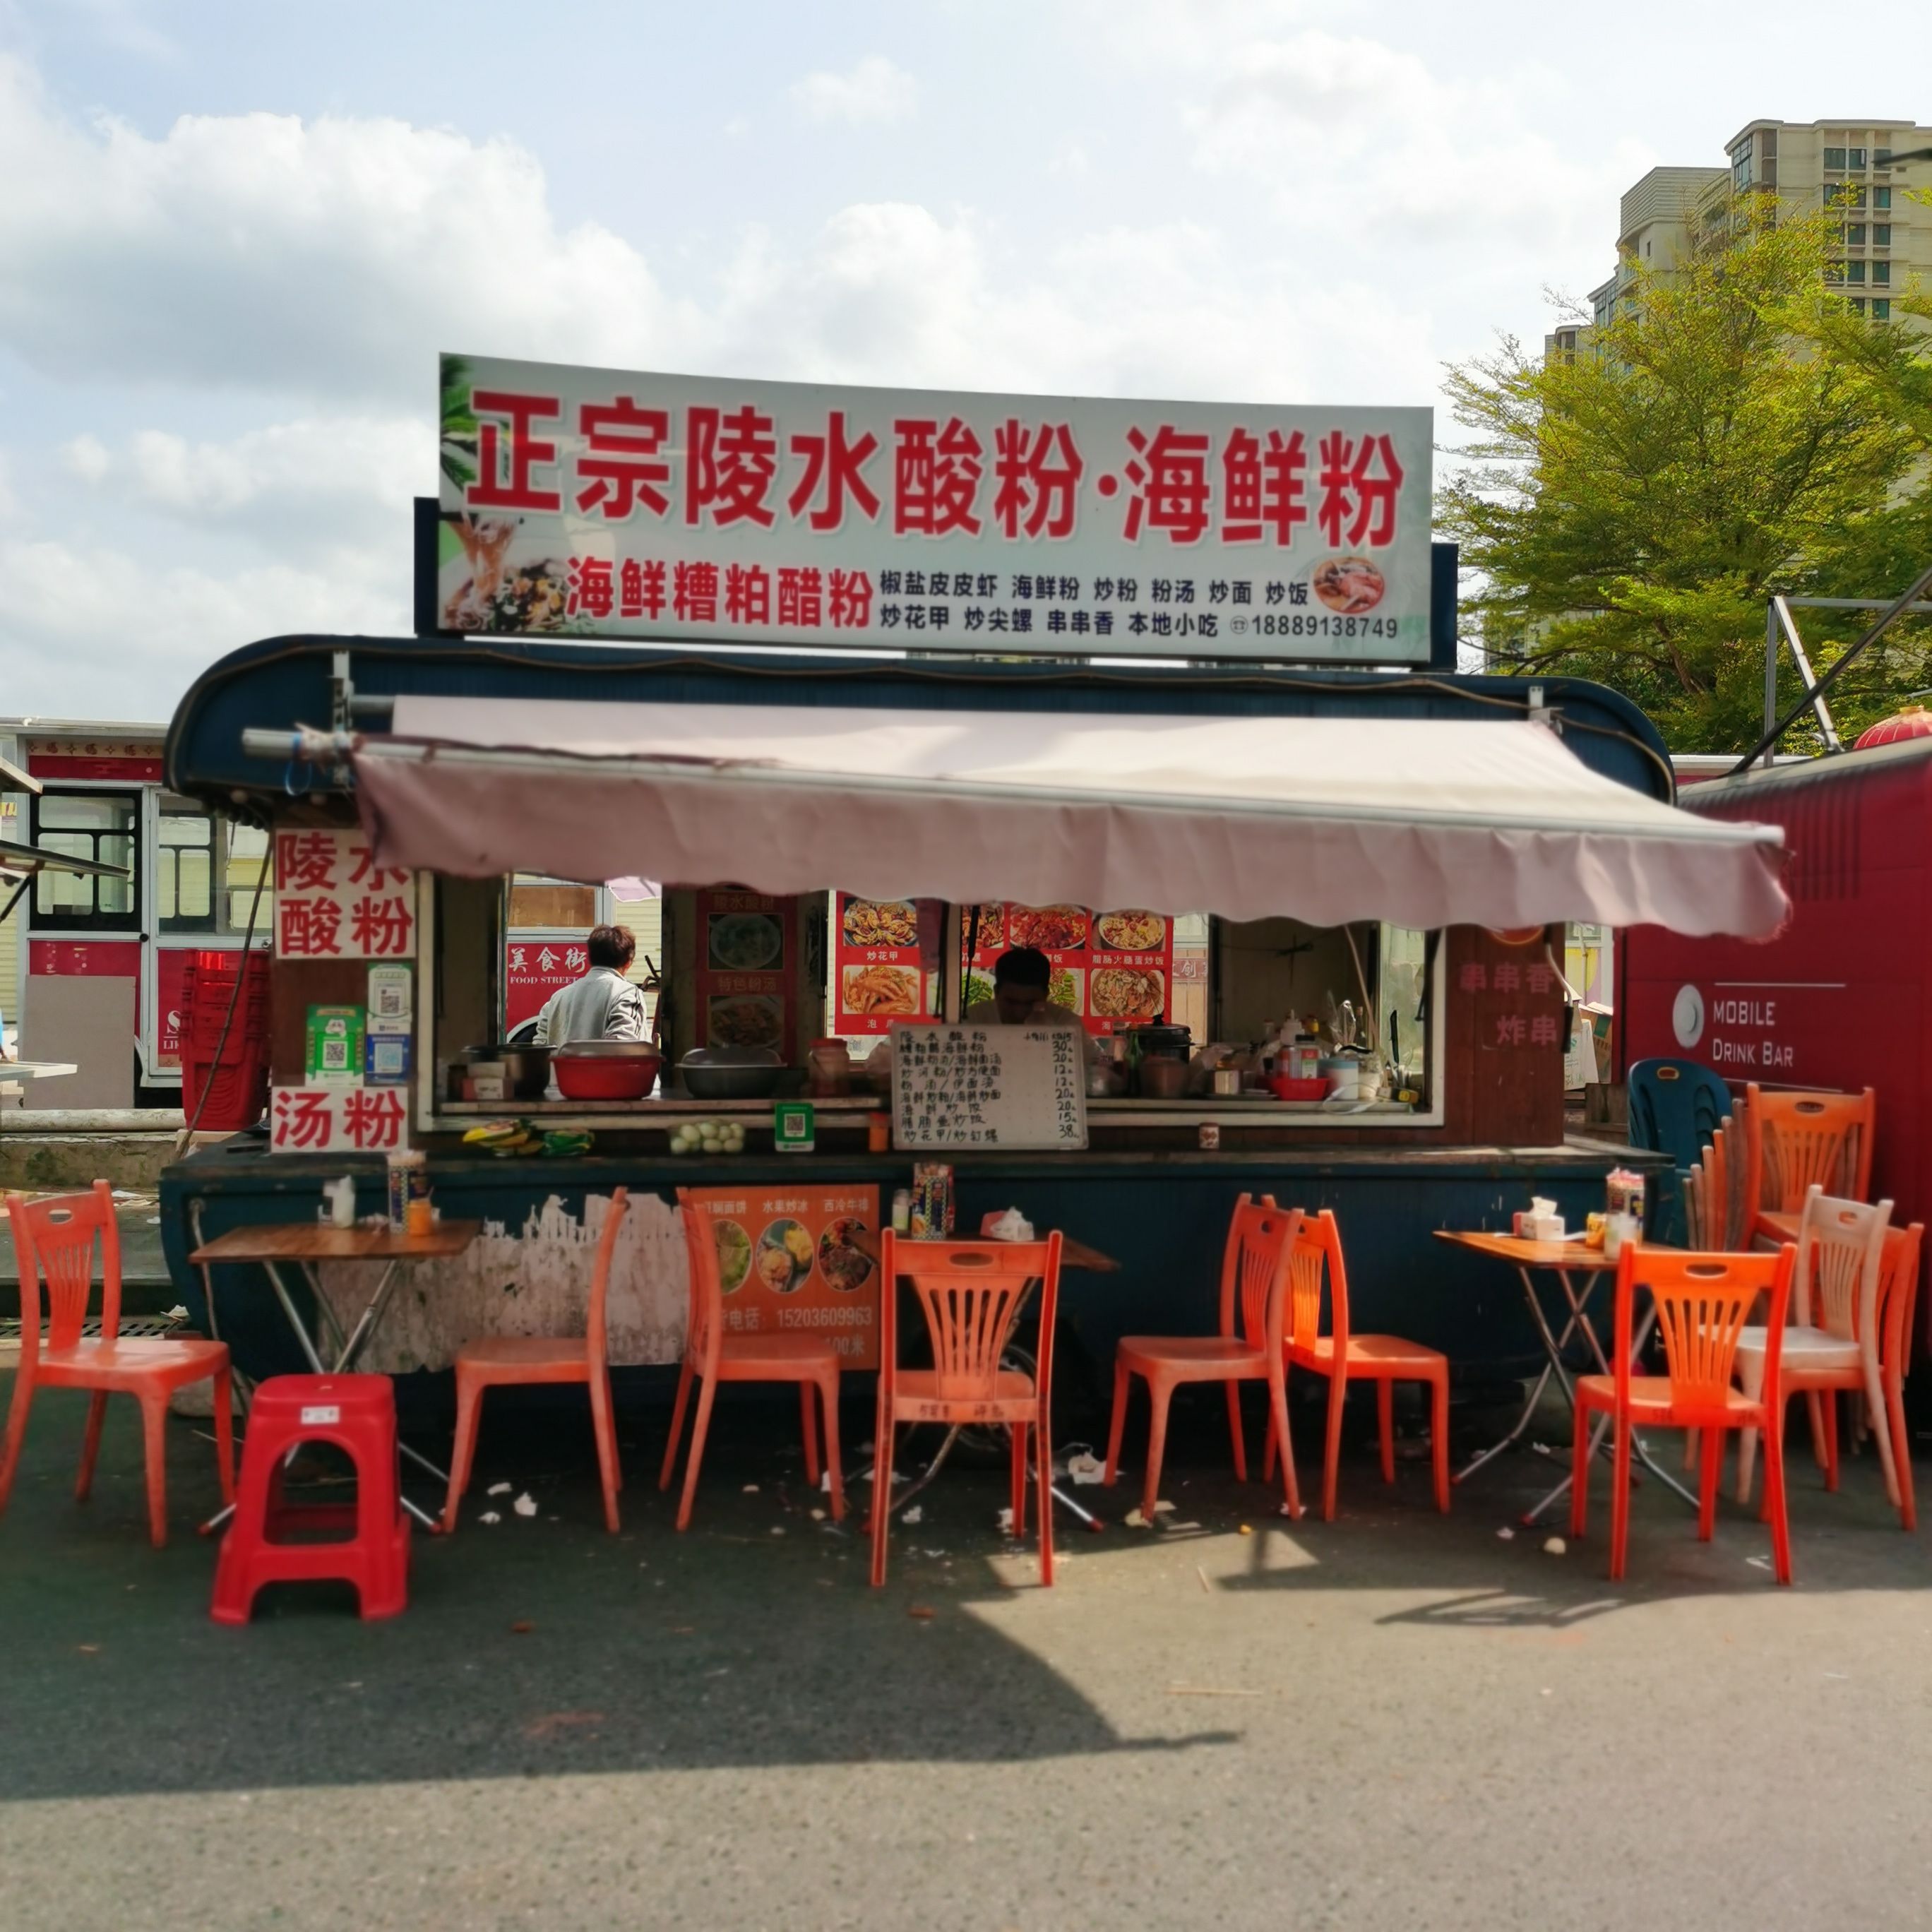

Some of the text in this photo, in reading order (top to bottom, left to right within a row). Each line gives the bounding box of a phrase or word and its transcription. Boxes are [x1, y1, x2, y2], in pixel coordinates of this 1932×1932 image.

[566, 556, 874, 628] 海鲜糟粕醋粉
[880, 570, 1308, 607] 椒盐皮皮虾 海鲜粉 炒粉 粉汤 炒面 炒饭
[880, 603, 1398, 639] 炒花甲 炒尖螺 串串香 本地小吃 18889138749
[280, 897, 412, 955] 酸粉
[508, 946, 587, 973] 美食街
[866, 950, 898, 961] 炒花甲
[540, 976, 578, 984] STREET
[1460, 962, 1554, 994] 串串香
[1713, 1001, 1775, 1026] MOBILE
[1496, 1014, 1557, 1046] 炸串
[1713, 1039, 1793, 1068] DRINK BAR
[273, 1090, 405, 1149] 汤粉
[763, 1200, 808, 1213] 水果炒冰
[825, 1198, 869, 1212] 西冷牛排
[776, 1307, 872, 1328] 15203609963
